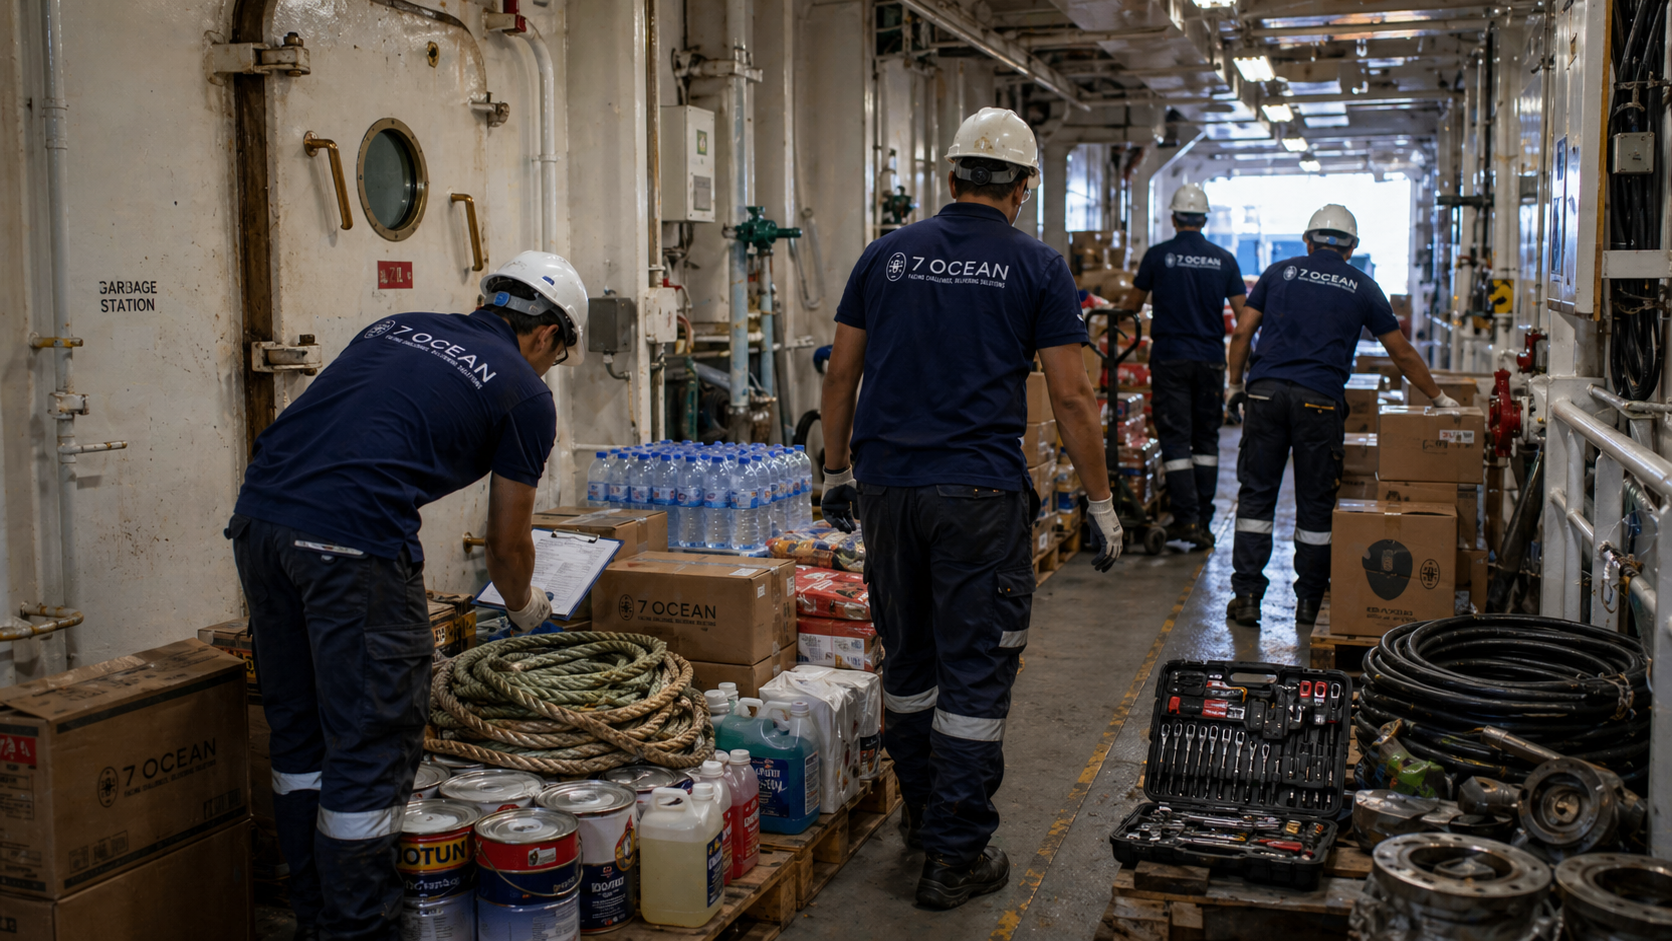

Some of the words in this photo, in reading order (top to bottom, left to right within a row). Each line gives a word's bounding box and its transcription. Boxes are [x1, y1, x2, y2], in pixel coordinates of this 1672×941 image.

[912, 256, 925, 271] 7
[929, 259, 1010, 281] OCEAN
[1184, 255, 1221, 266] OCEAN
[99, 280, 157, 295] GARBAGE
[1300, 268, 1309, 277] 7
[1310, 271, 1358, 290] OCEAN
[100, 298, 155, 313] STATION
[393, 325, 413, 335] 7
[412, 332, 497, 383] OCEAN
[637, 599, 648, 614] 7
[652, 601, 716, 620] OCEAN
[122, 764, 136, 787] 7
[142, 737, 216, 779] OCEAN
